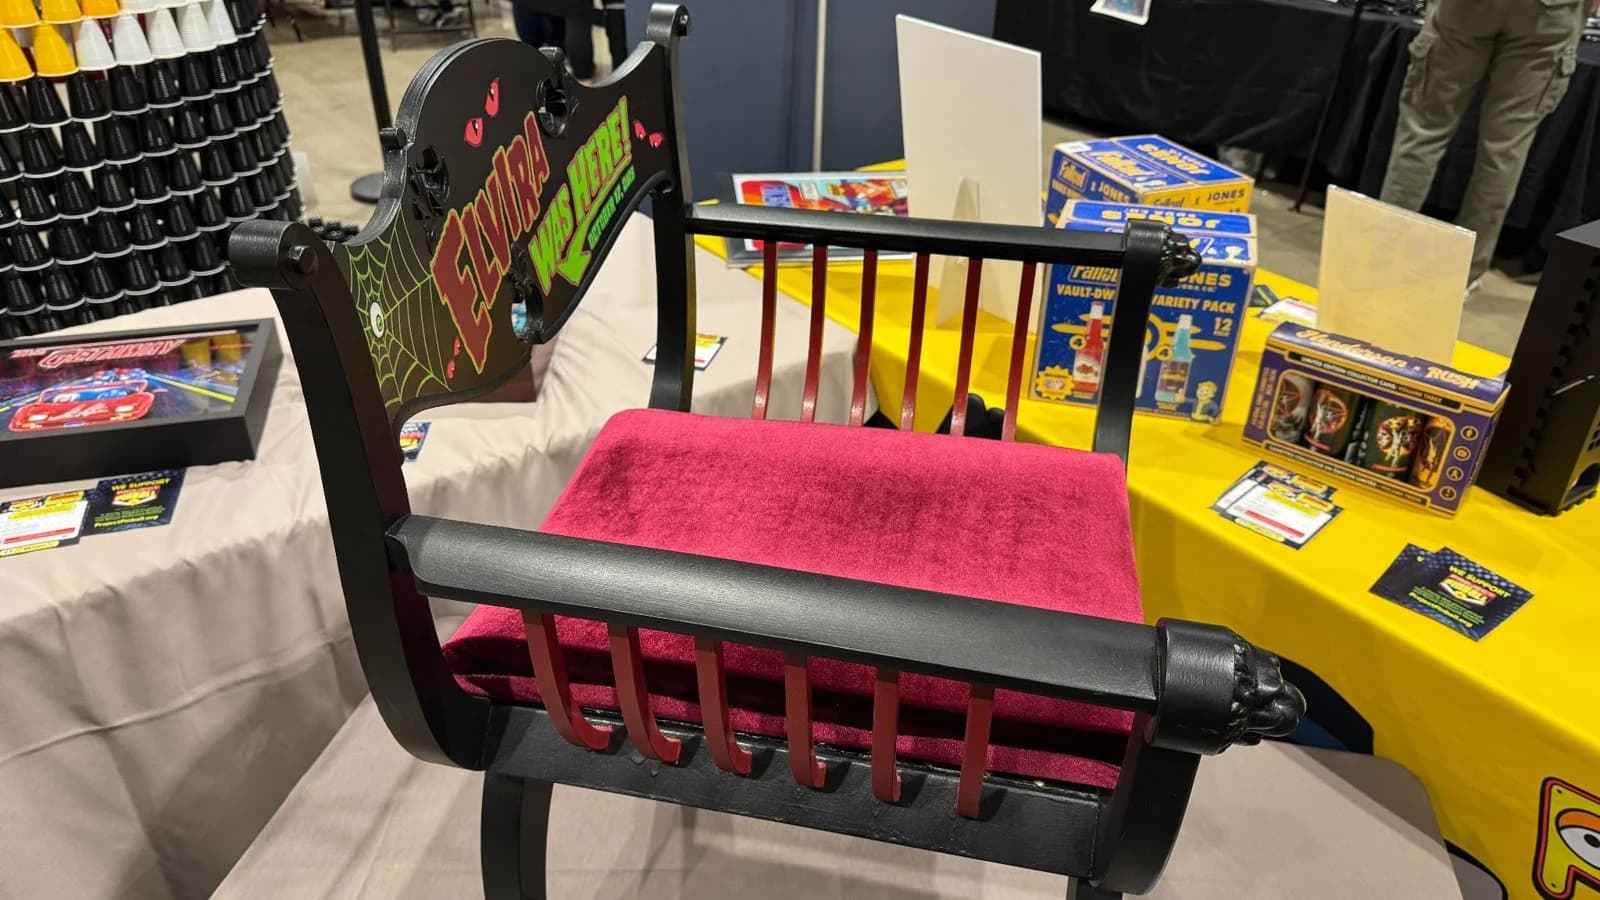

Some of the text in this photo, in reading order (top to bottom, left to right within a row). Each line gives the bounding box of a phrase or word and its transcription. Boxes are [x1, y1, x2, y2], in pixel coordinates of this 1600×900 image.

[528, 95, 632, 296] WAS HERE!
[1098, 181, 1130, 203] JONES
[1207, 188, 1246, 202] JONES
[431, 111, 550, 375] ELVIRA
[1056, 284, 1116, 300] VAULT-DW
[1202, 299, 1237, 315] PACK
[1214, 317, 1233, 332] 12
[1296, 329, 1408, 368] Henderson
[1424, 366, 1481, 391] RUSH
[128, 478, 171, 488] SUPPORT
[1449, 565, 1512, 598] WE SUPPORT
